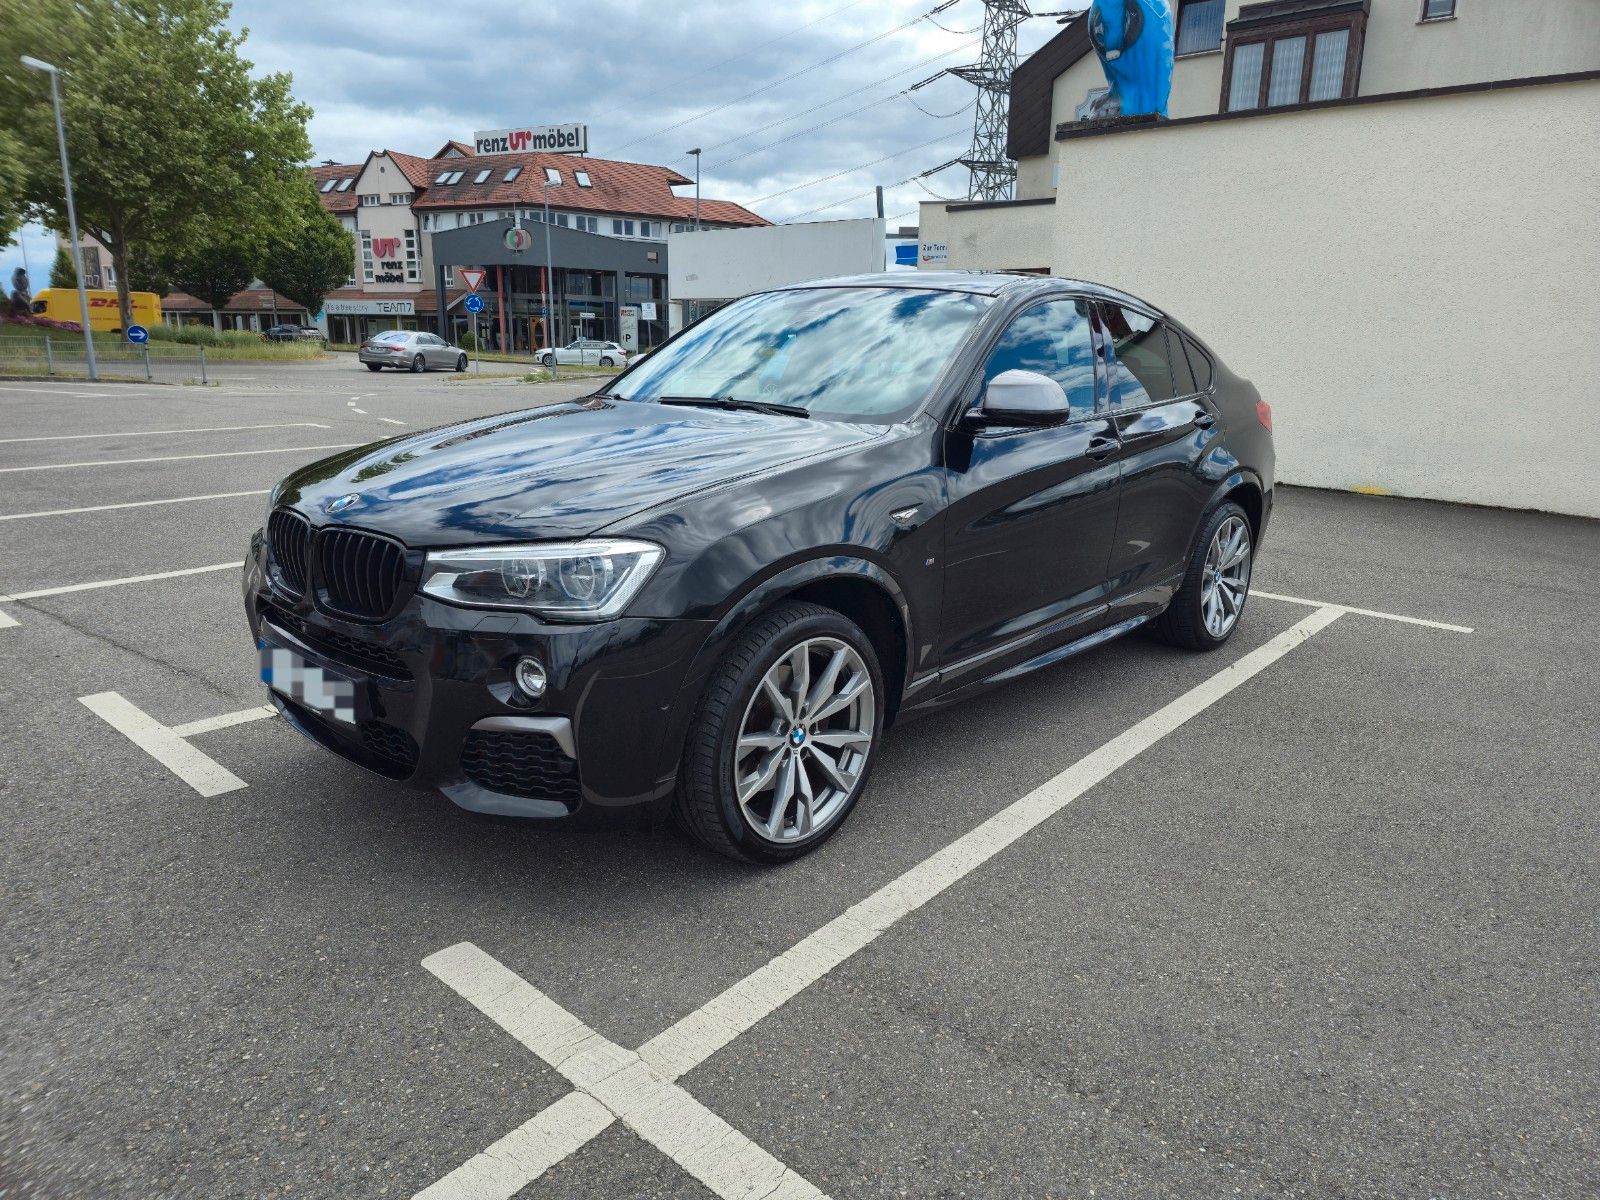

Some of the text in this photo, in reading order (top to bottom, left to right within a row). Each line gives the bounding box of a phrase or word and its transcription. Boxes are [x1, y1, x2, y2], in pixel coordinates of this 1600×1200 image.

[476, 137, 508, 153] renz
[533, 127, 579, 149] möbel
[380, 261, 403, 270] renz
[374, 272, 404, 283] möbel
